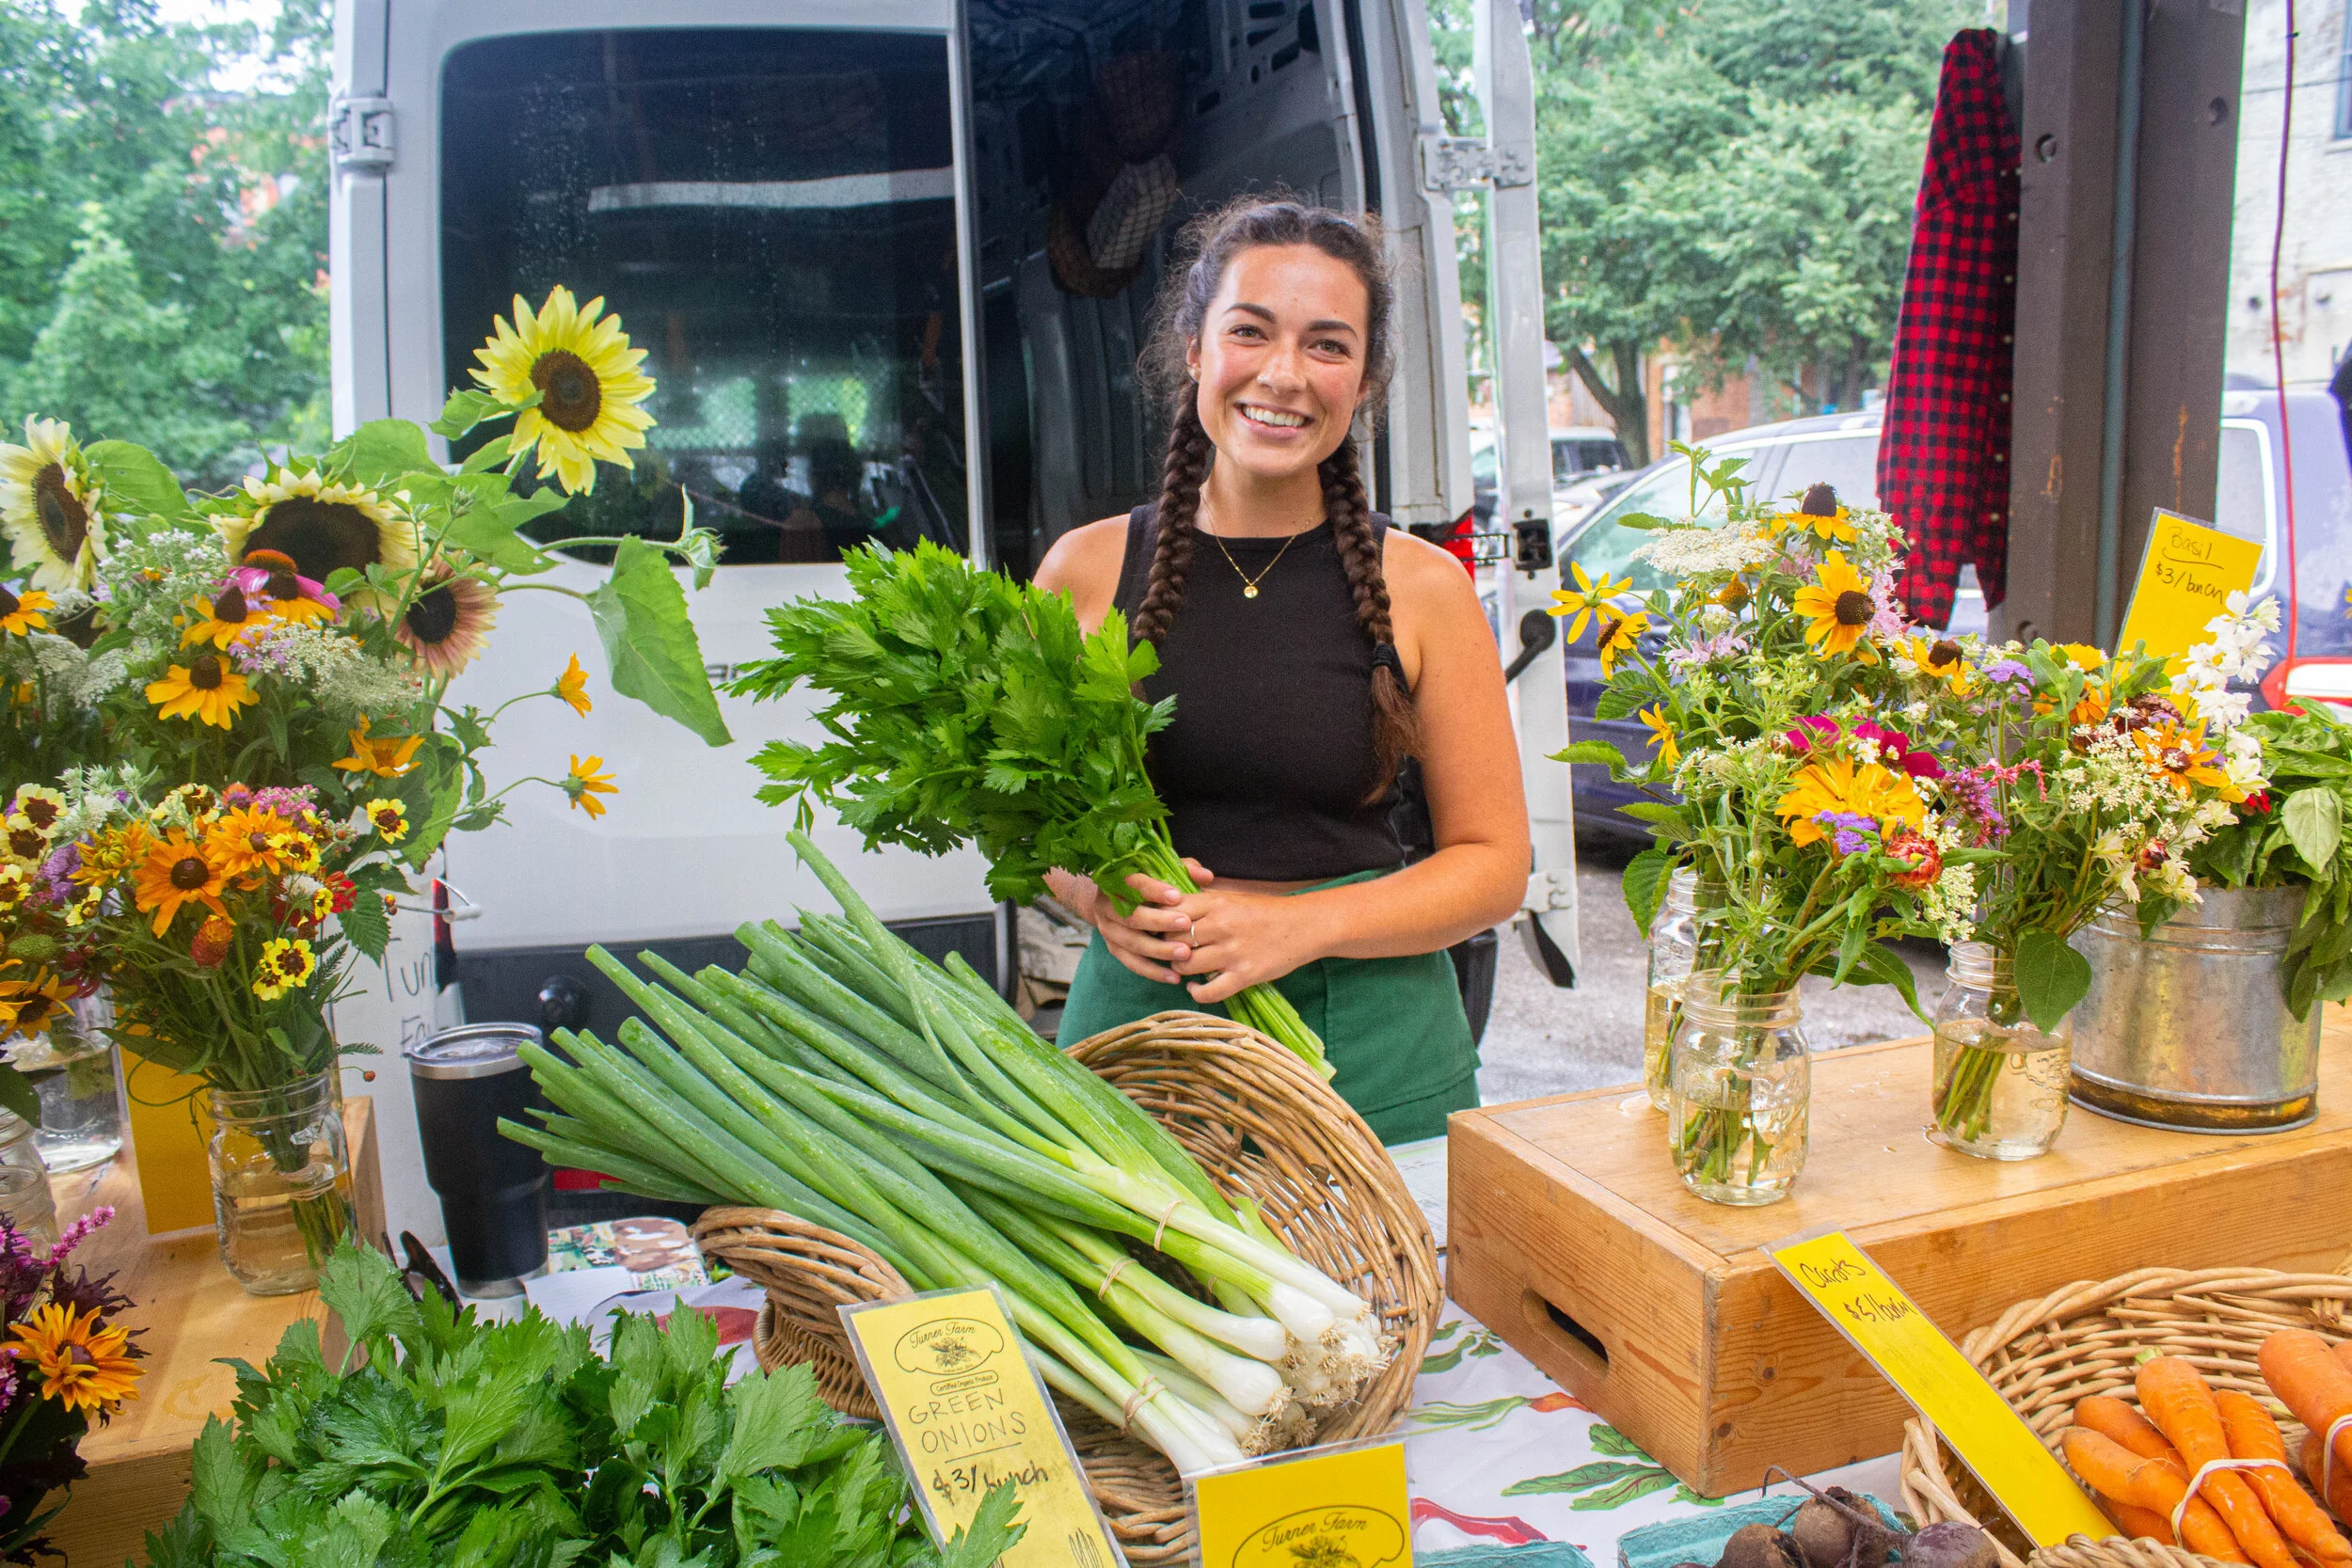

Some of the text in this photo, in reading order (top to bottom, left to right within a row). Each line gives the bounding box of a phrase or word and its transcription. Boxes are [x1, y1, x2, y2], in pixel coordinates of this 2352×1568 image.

[2169, 526, 2213, 561] Basil
[910, 1321, 977, 1349] Turner Farm
[936, 1381, 957, 1392] Certified
[908, 1387, 1005, 1424] GREEN
[921, 1411, 1026, 1453] ONIONS
[1262, 1511, 1368, 1553] Turner Farm
